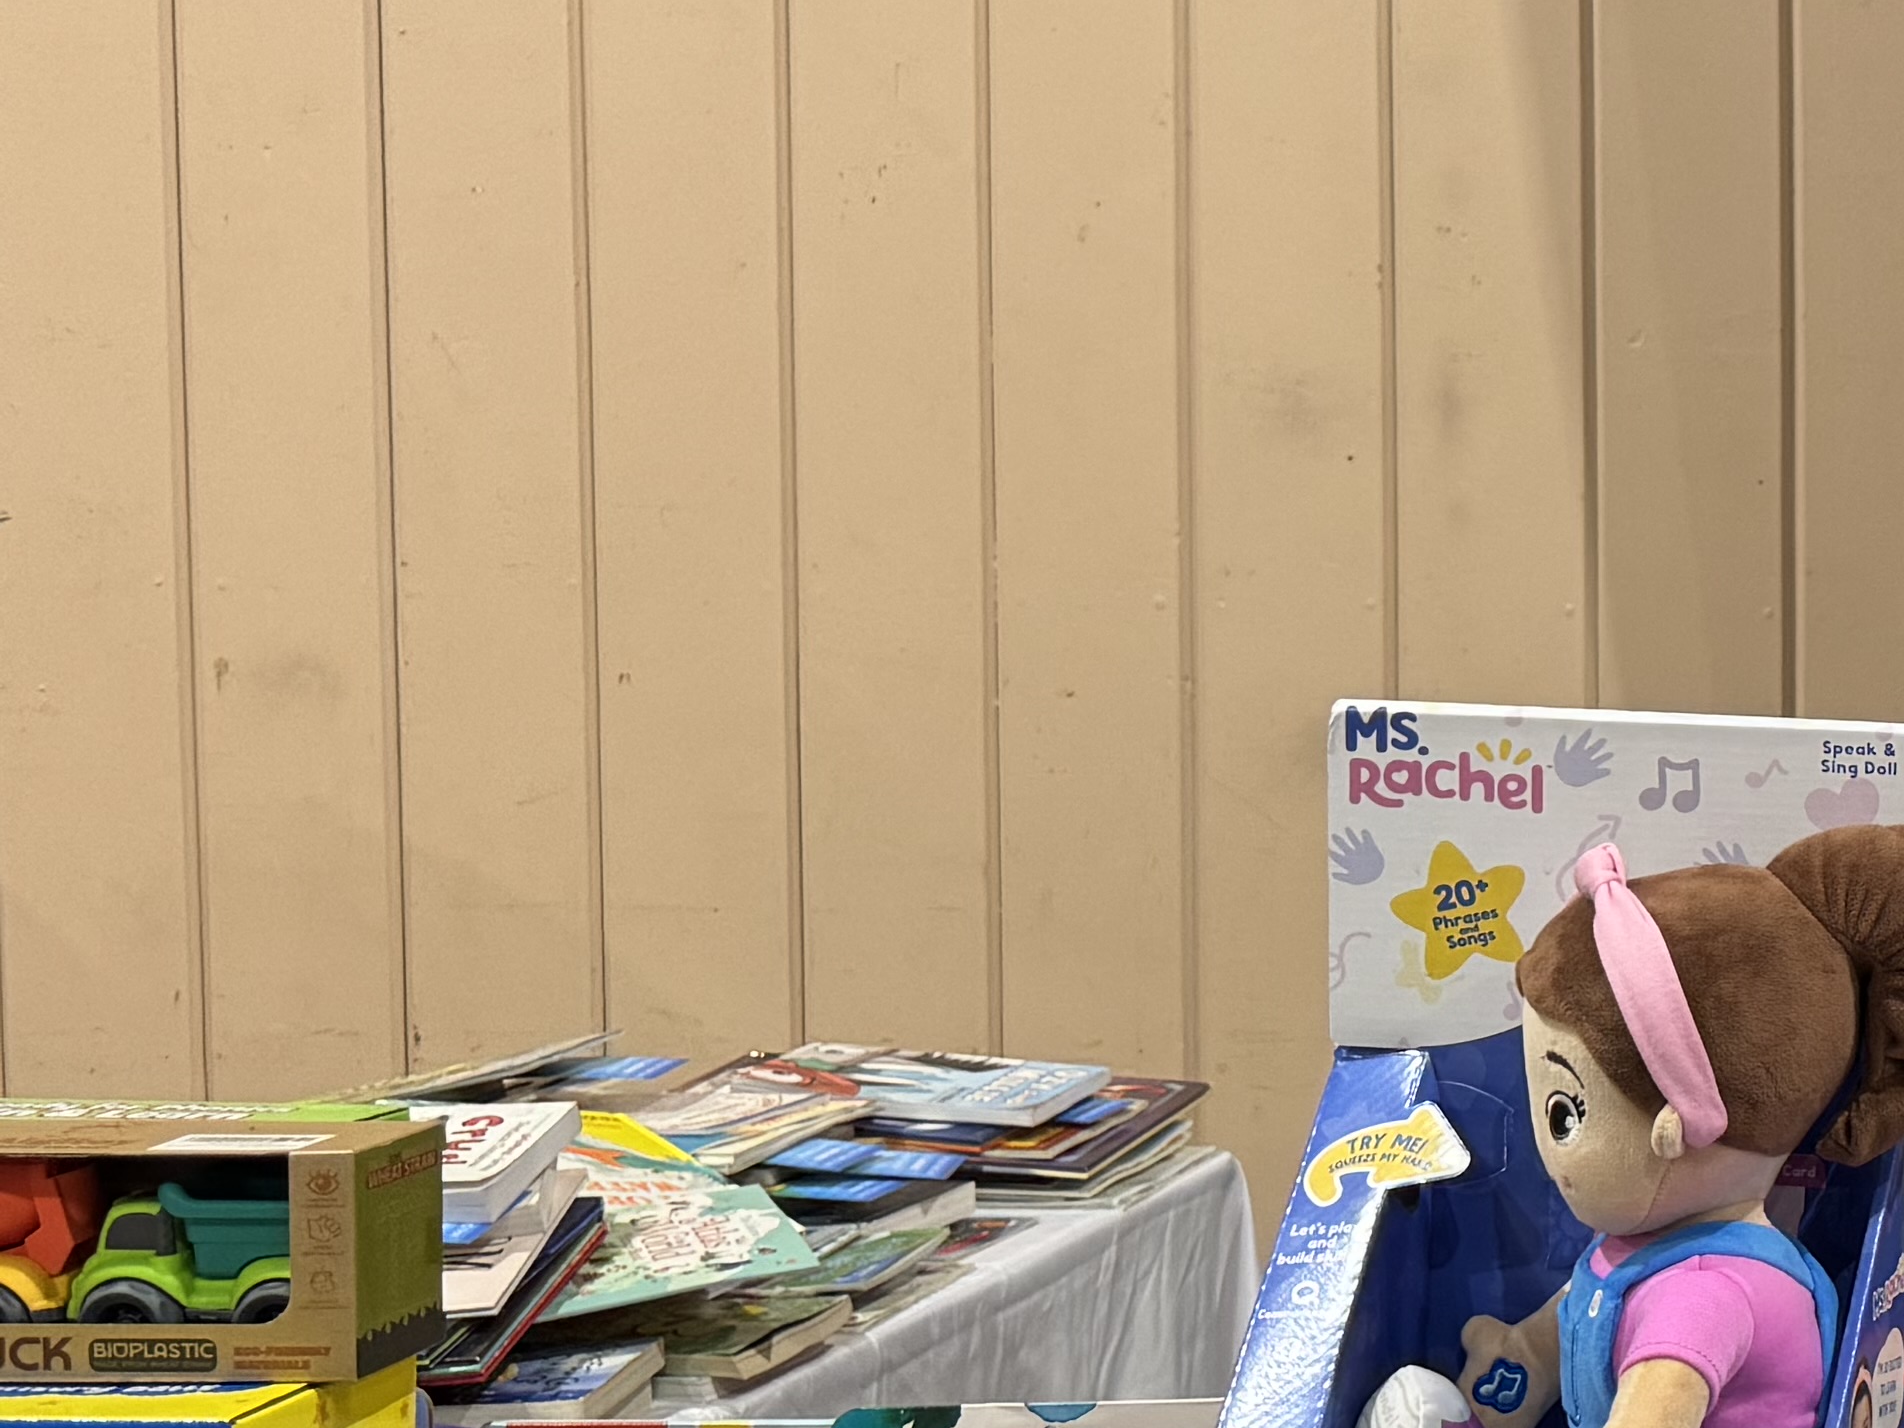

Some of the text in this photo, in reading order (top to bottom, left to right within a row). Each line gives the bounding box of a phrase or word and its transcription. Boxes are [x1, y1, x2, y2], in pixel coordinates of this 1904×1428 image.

[1822, 740, 1896, 760] Speak &
[1820, 759, 1897, 779] Sing Doll
[1349, 752, 1544, 813] Rachel
[1436, 878, 1489, 912] 20+
[1347, 1134, 1430, 1155] TRY ME!
[1307, 1237, 1337, 1249] and
[92, 1342, 214, 1361] BIOPLASTIC
